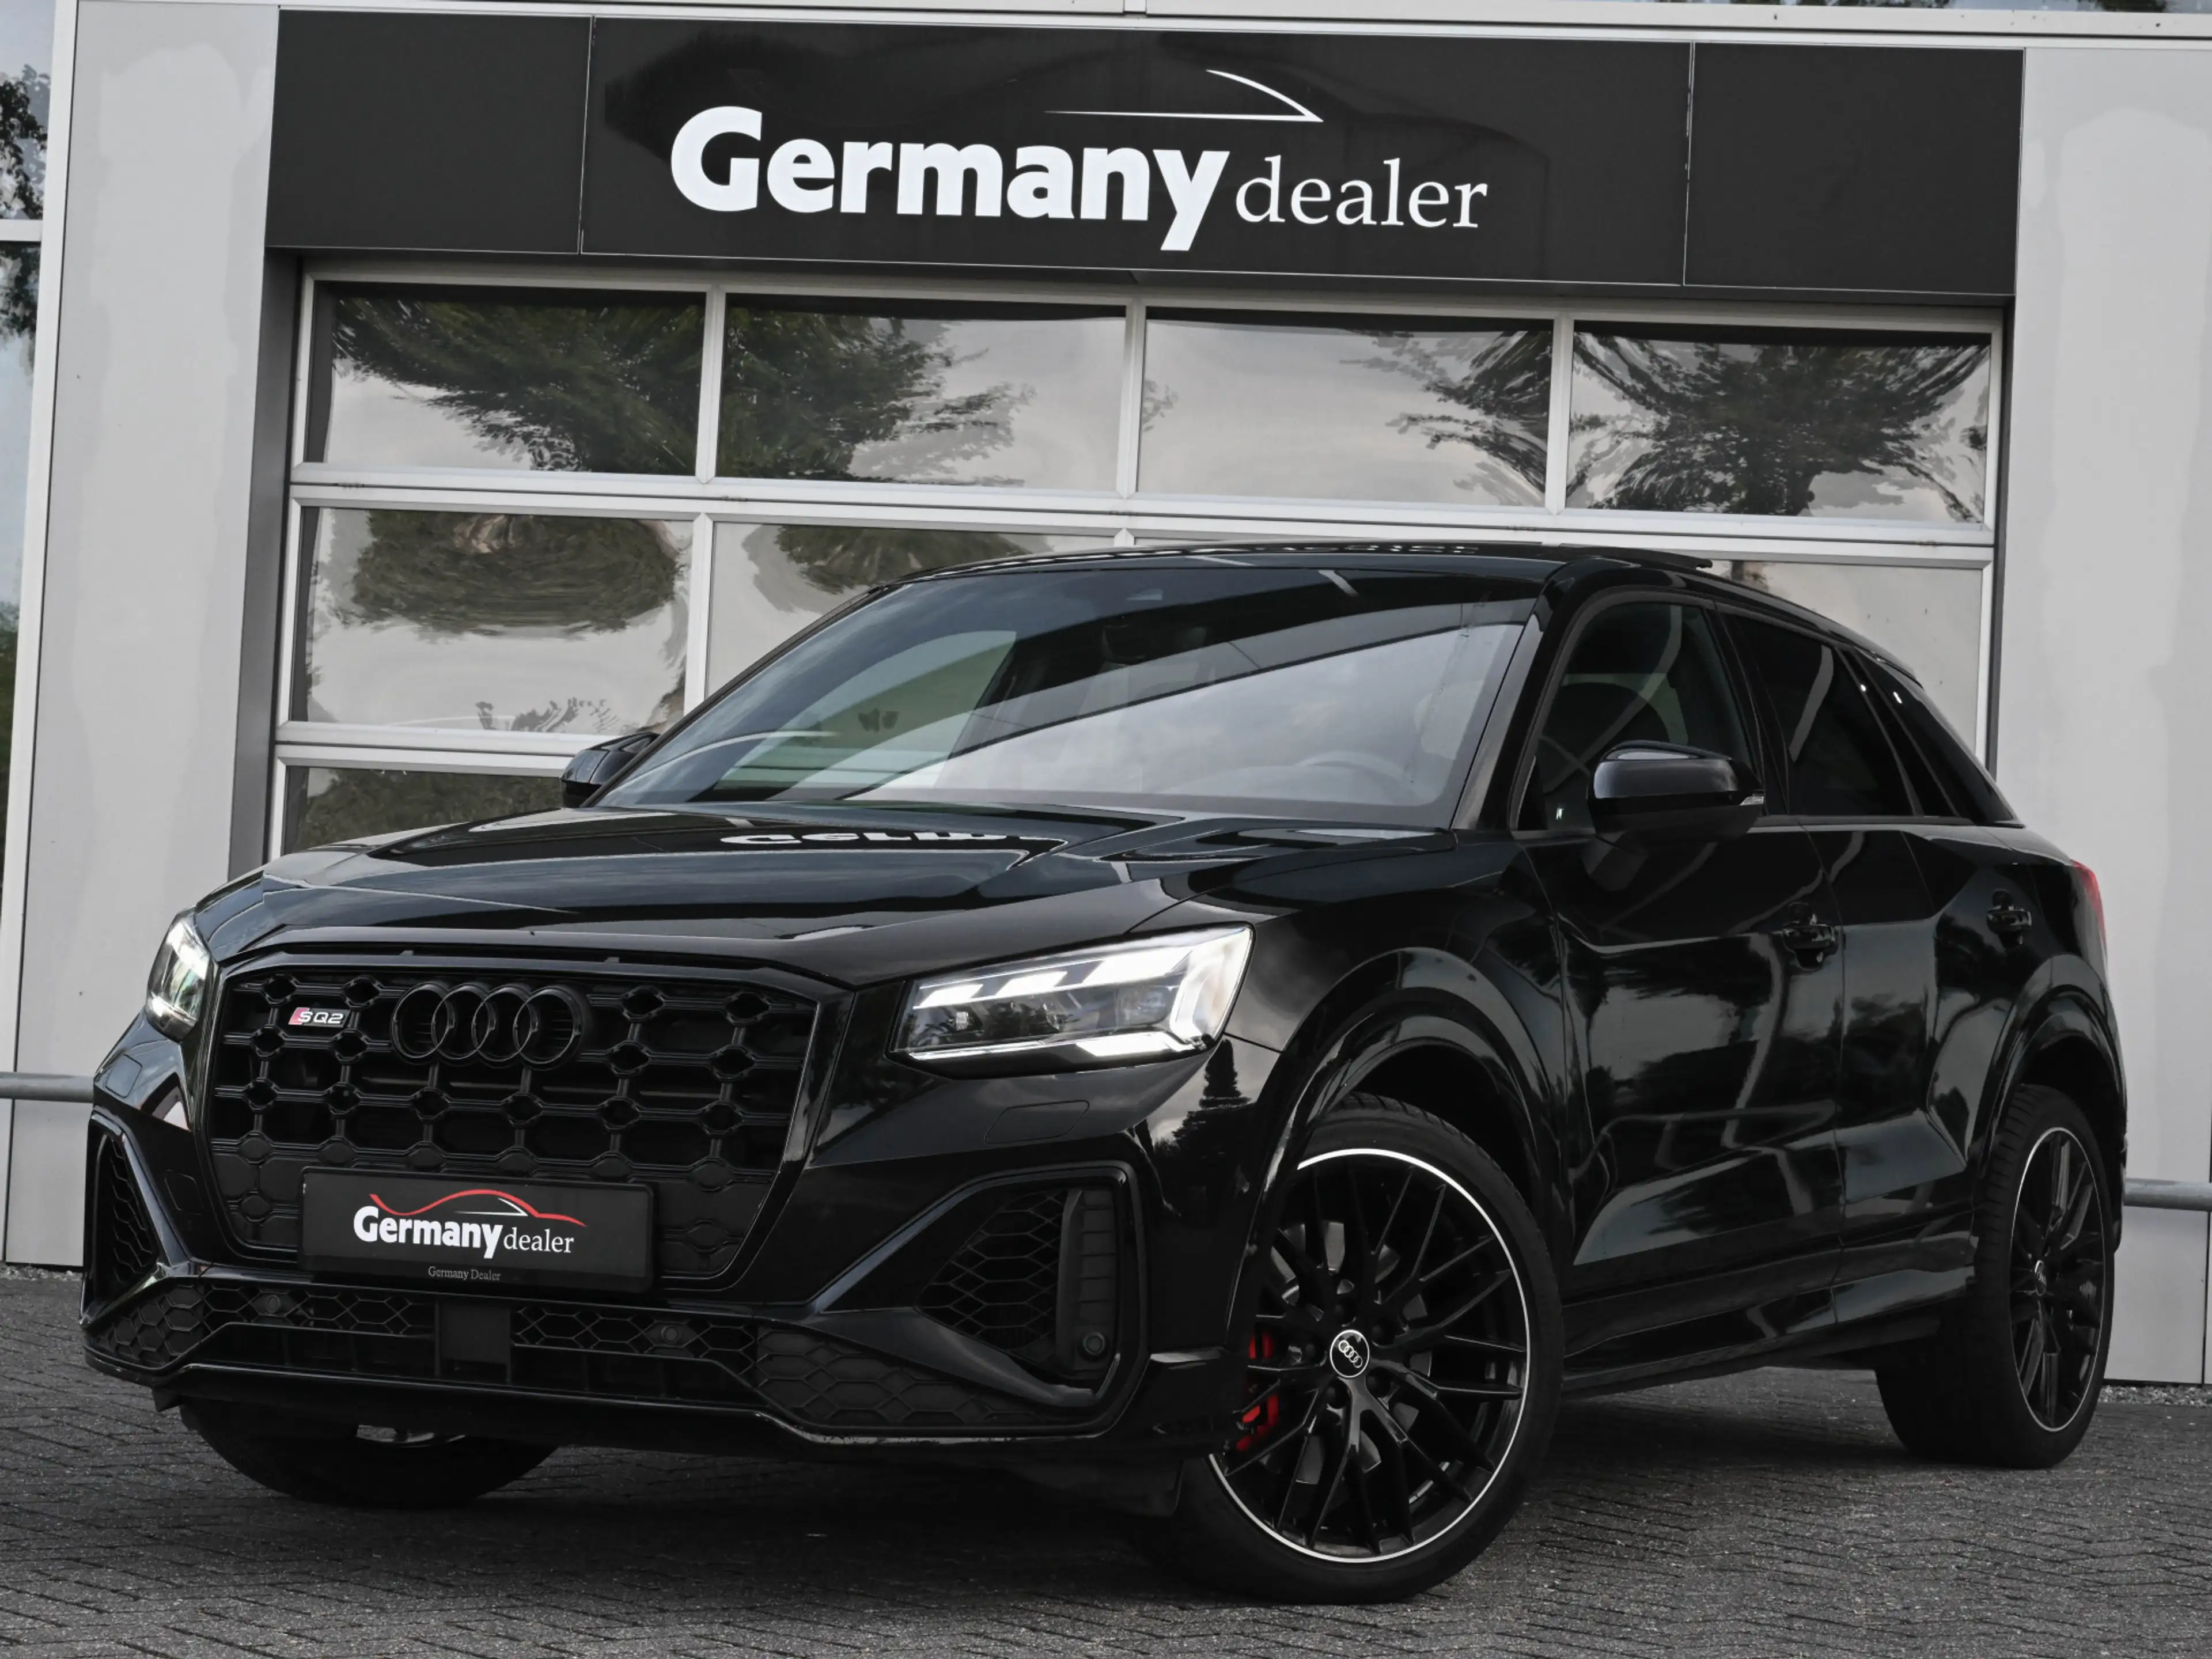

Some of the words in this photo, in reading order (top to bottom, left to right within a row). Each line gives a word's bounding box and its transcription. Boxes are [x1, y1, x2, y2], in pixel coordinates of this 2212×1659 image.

[671, 106, 1230, 251] Germany
[1236, 155, 1488, 228] dealer
[297, 1012, 344, 1024] SQ2
[353, 1205, 503, 1259] Germany
[503, 1226, 574, 1253] dealer
[428, 1266, 469, 1281] Germany
[470, 1268, 501, 1281] Dealer
